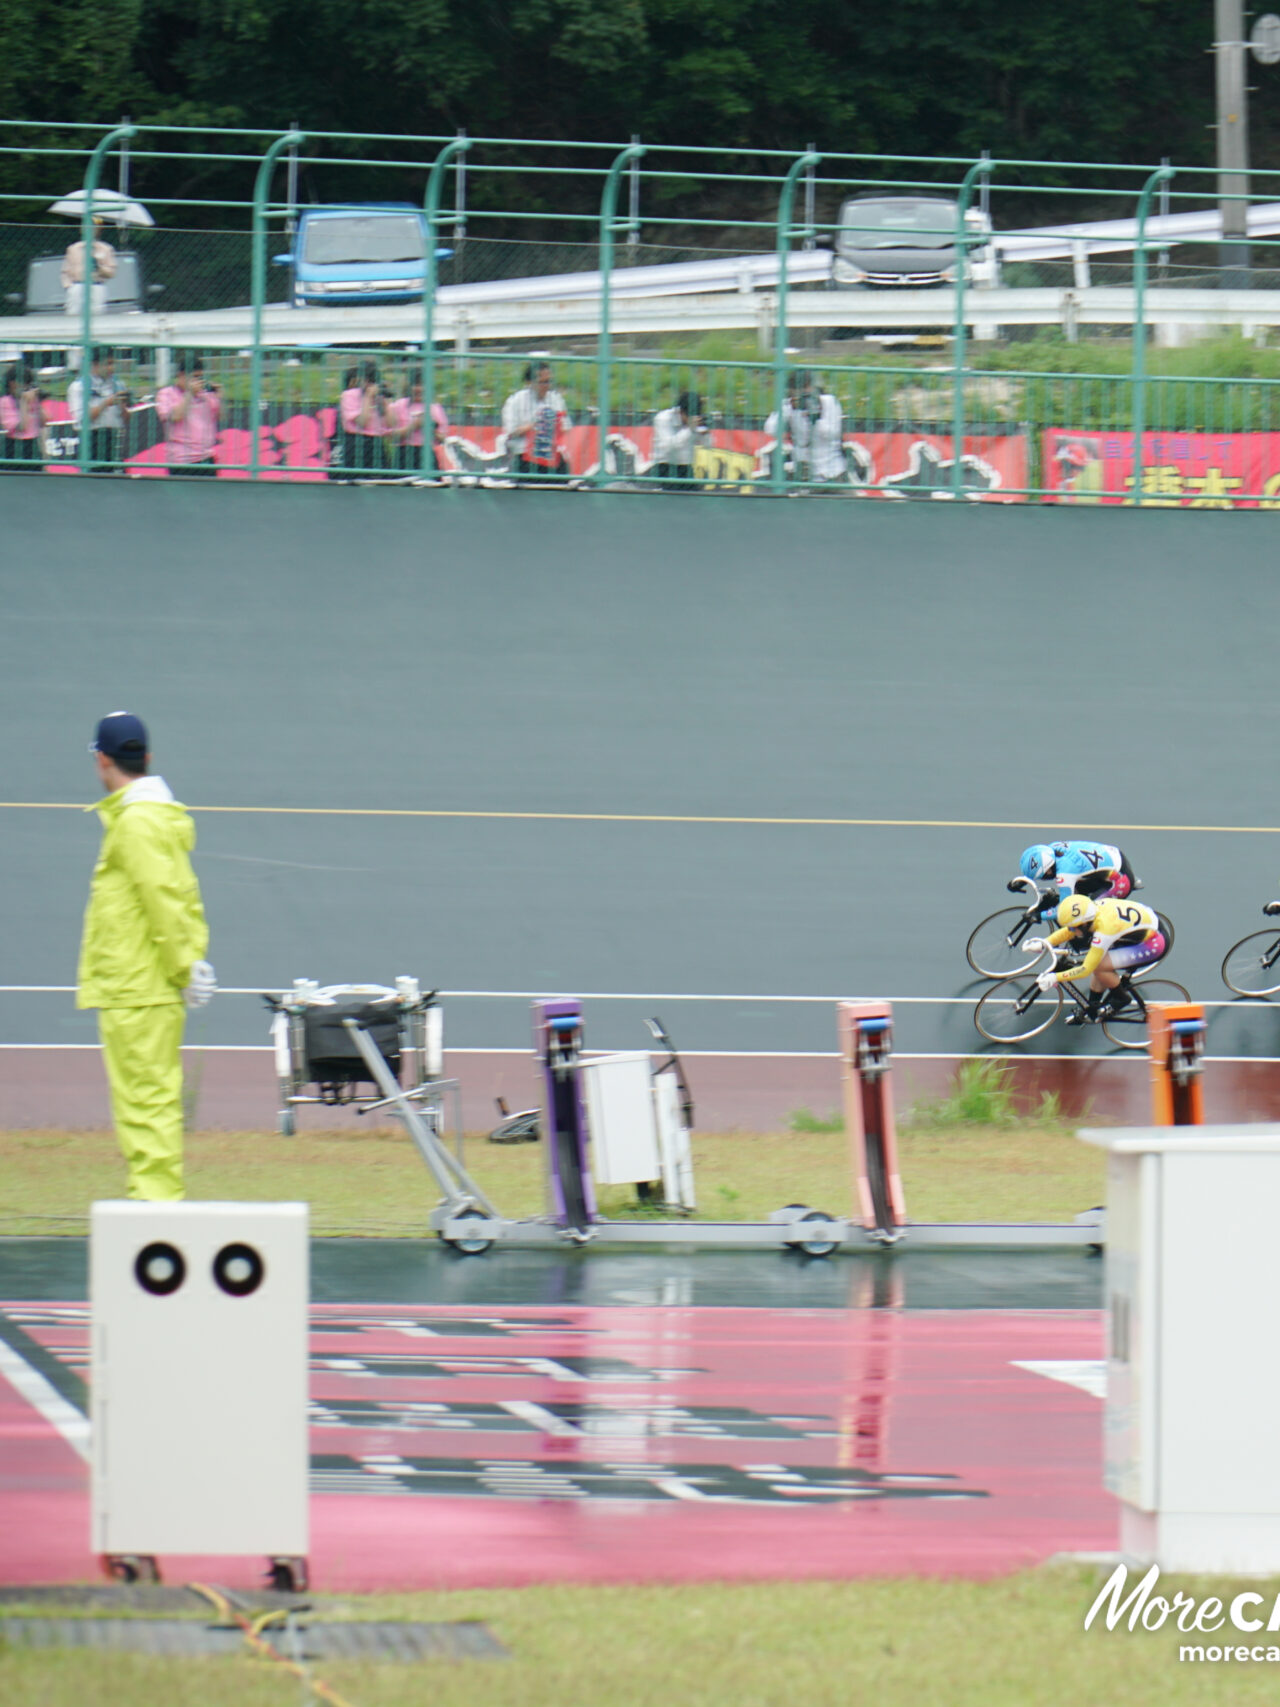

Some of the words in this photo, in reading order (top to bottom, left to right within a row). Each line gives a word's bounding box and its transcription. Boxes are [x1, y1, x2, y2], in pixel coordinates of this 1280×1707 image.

[1031, 857, 1038, 870] 4
[1080, 850, 1104, 869] 4
[1072, 904, 1081, 917] 5
[1116, 906, 1142, 926] 5
